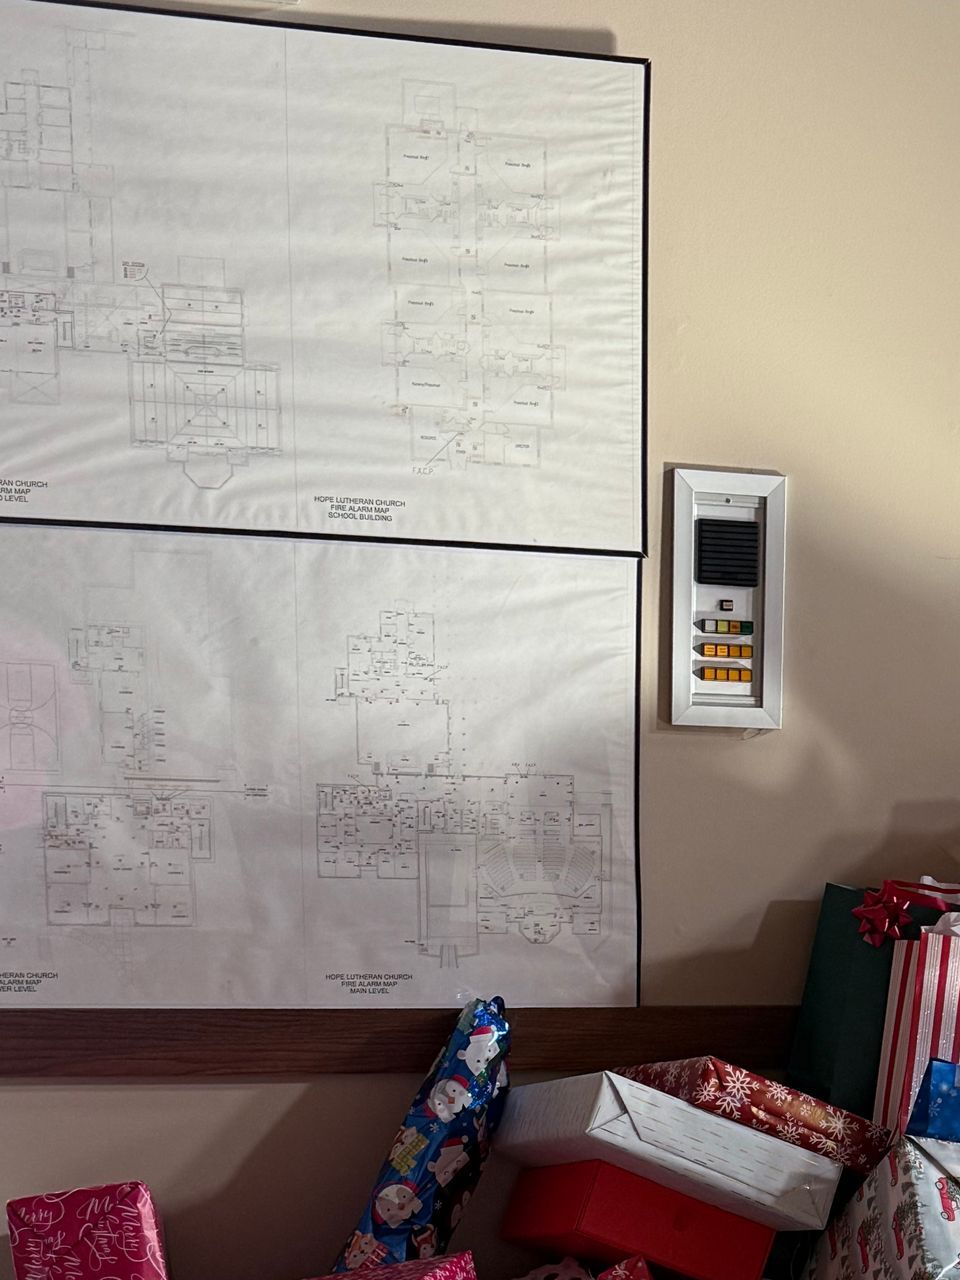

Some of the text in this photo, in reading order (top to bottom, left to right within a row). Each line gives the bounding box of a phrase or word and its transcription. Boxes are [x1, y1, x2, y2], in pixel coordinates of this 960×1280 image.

[15, 480, 48, 488] CHURCH
[4, 495, 29, 503] LEVEL
[314, 495, 406, 507] HOPE LUTHERAN CHURCH
[328, 512, 358, 520] SCHOOL
